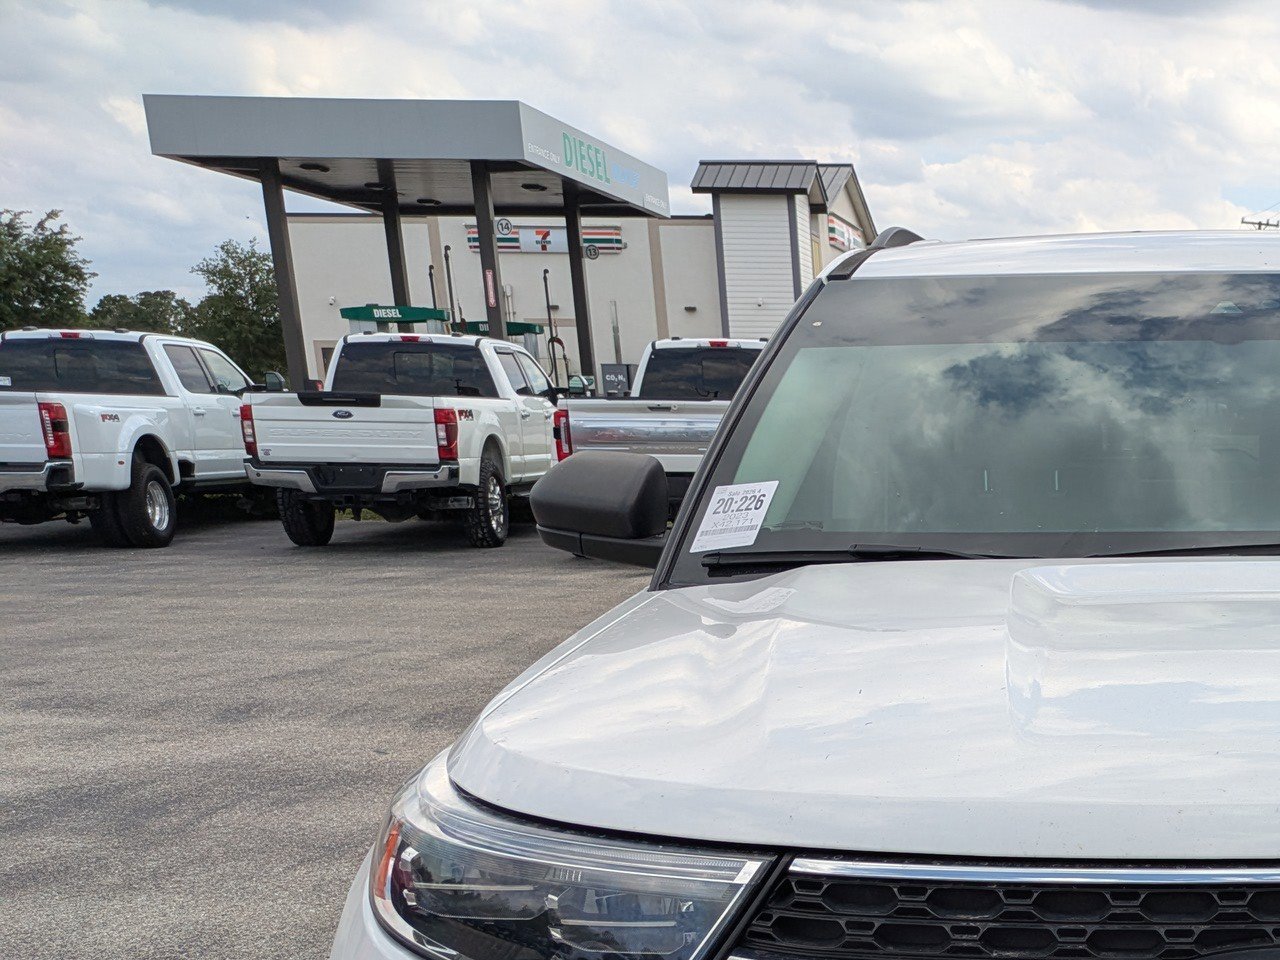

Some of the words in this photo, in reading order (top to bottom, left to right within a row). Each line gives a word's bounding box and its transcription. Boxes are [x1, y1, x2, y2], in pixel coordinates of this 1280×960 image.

[562, 131, 611, 185] DIESEL
[499, 222, 510, 232] 14
[535, 229, 551, 251] 7
[587, 247, 597, 257] 13
[373, 308, 402, 318] DIESEL
[712, 494, 766, 515] 20:226
[723, 512, 749, 520] 2023
